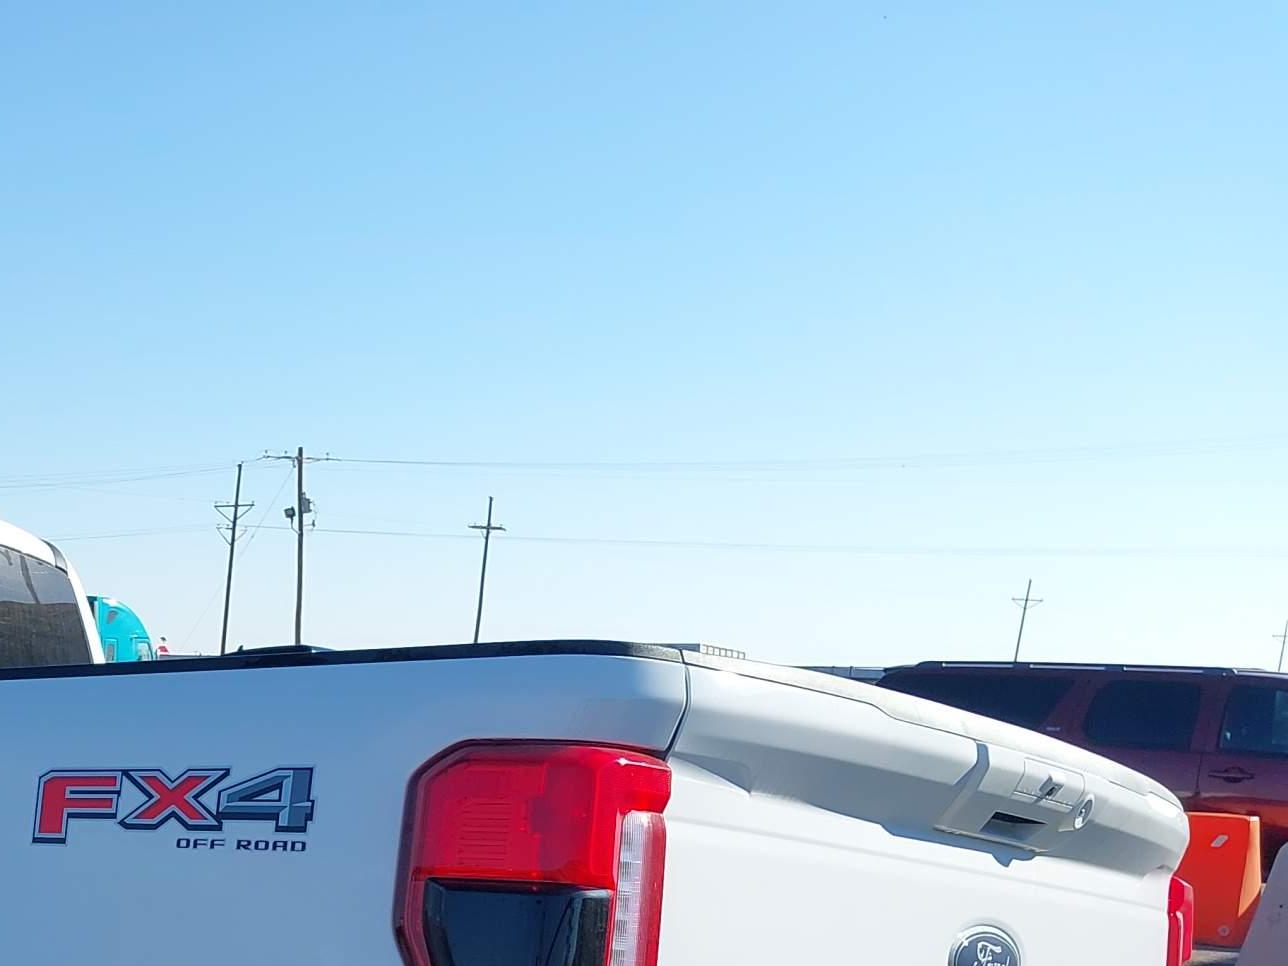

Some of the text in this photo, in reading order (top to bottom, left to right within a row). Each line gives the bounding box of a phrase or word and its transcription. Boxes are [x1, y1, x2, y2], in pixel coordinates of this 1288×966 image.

[32, 767, 315, 844] FX4
[176, 838, 308, 852] OFF ROAD
